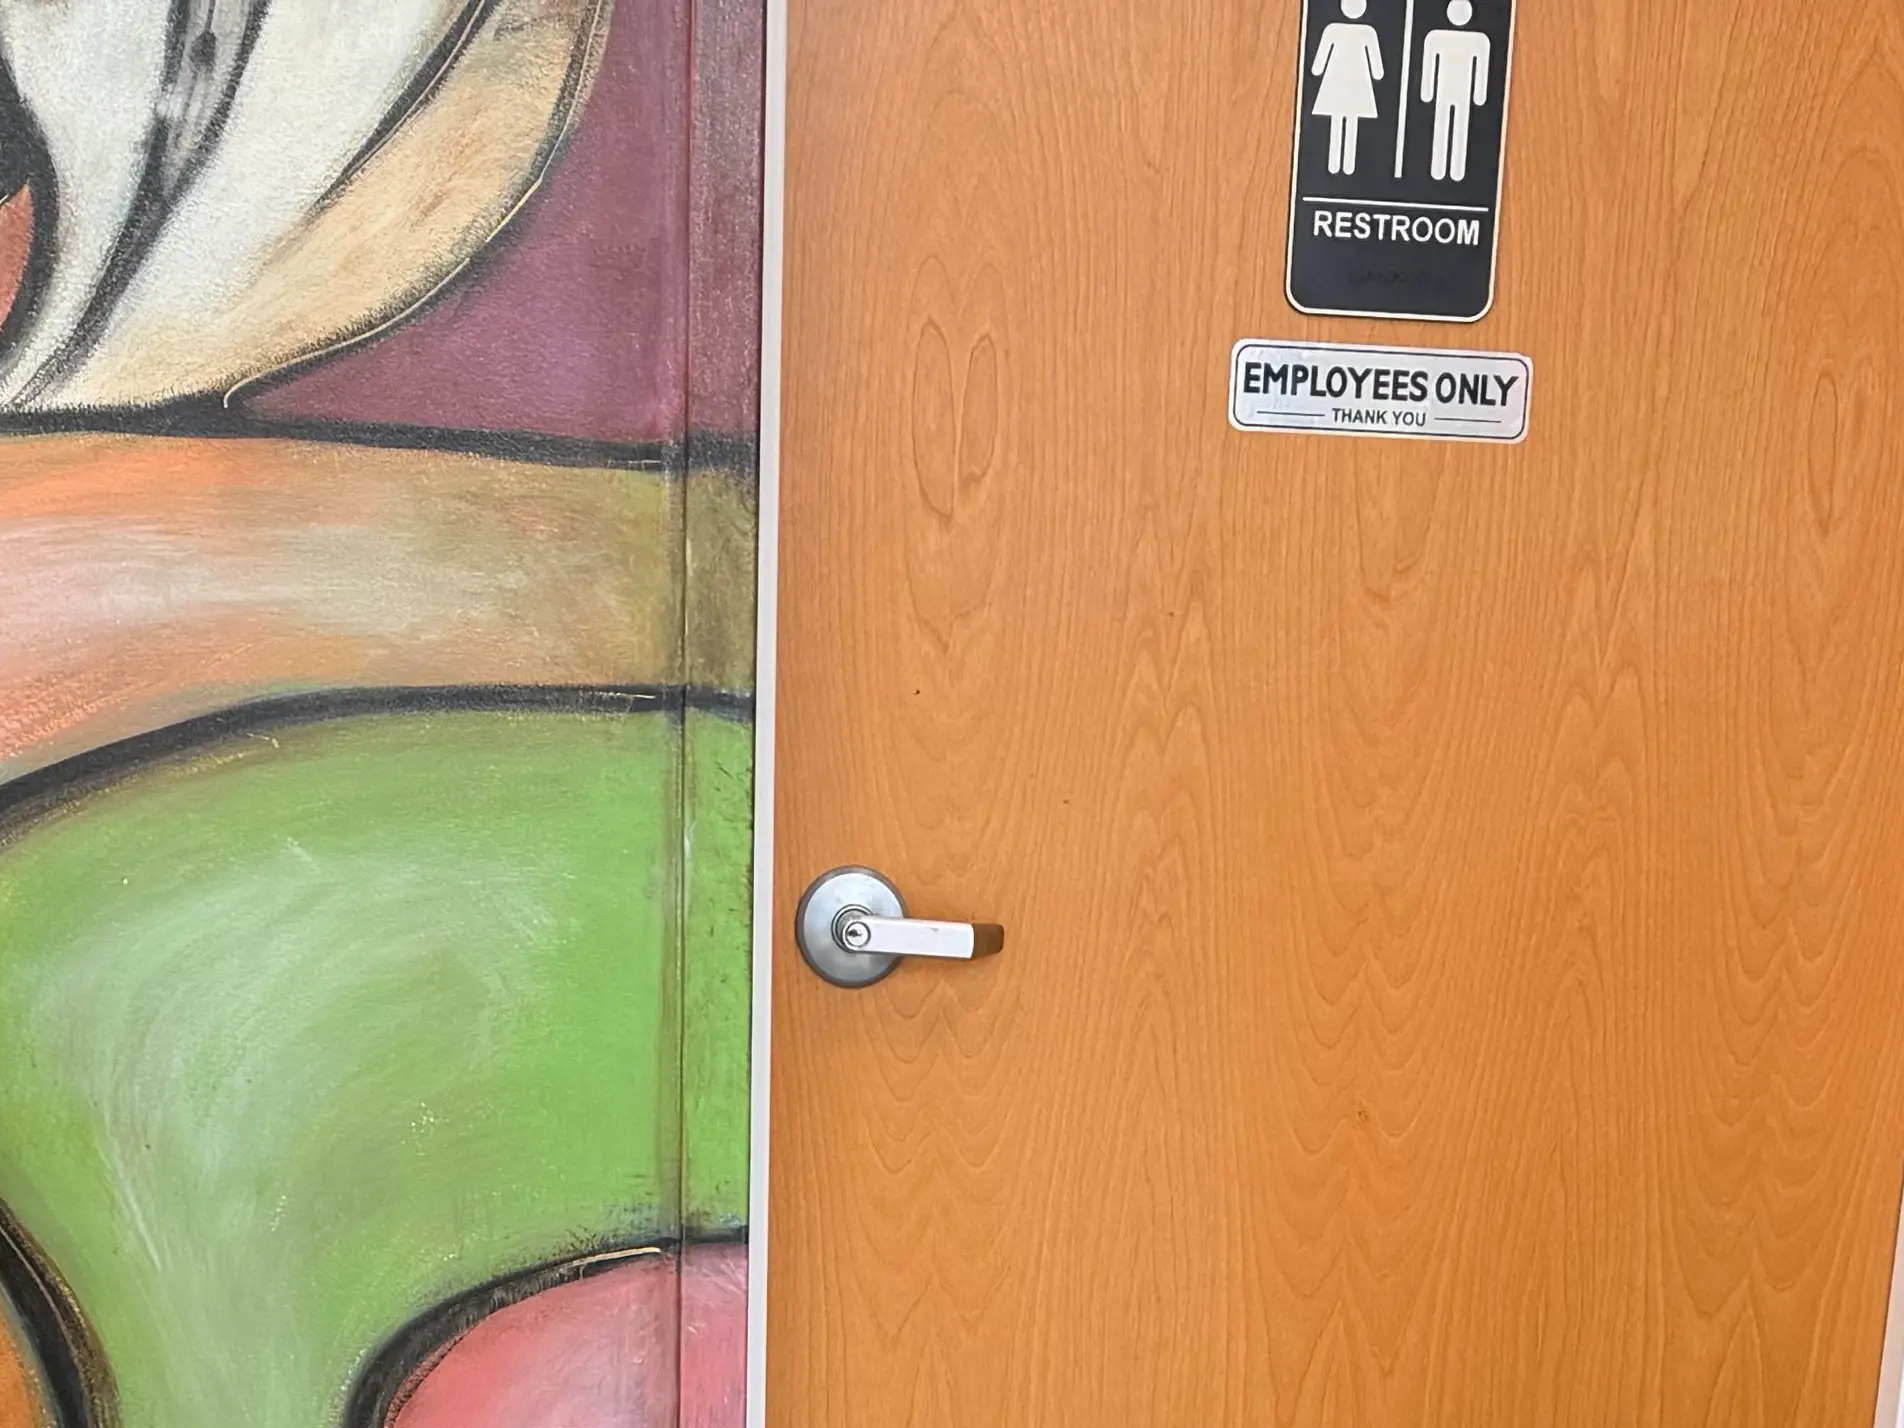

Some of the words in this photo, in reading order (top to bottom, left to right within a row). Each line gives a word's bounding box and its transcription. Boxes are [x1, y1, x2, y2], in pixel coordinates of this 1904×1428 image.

[1313, 211, 1480, 246] RESTROOM
[1244, 362, 1428, 401] EMPLOYEES
[1435, 373, 1519, 406] ONLY
[1331, 407, 1387, 425] THANK
[1390, 410, 1426, 427] YOU
